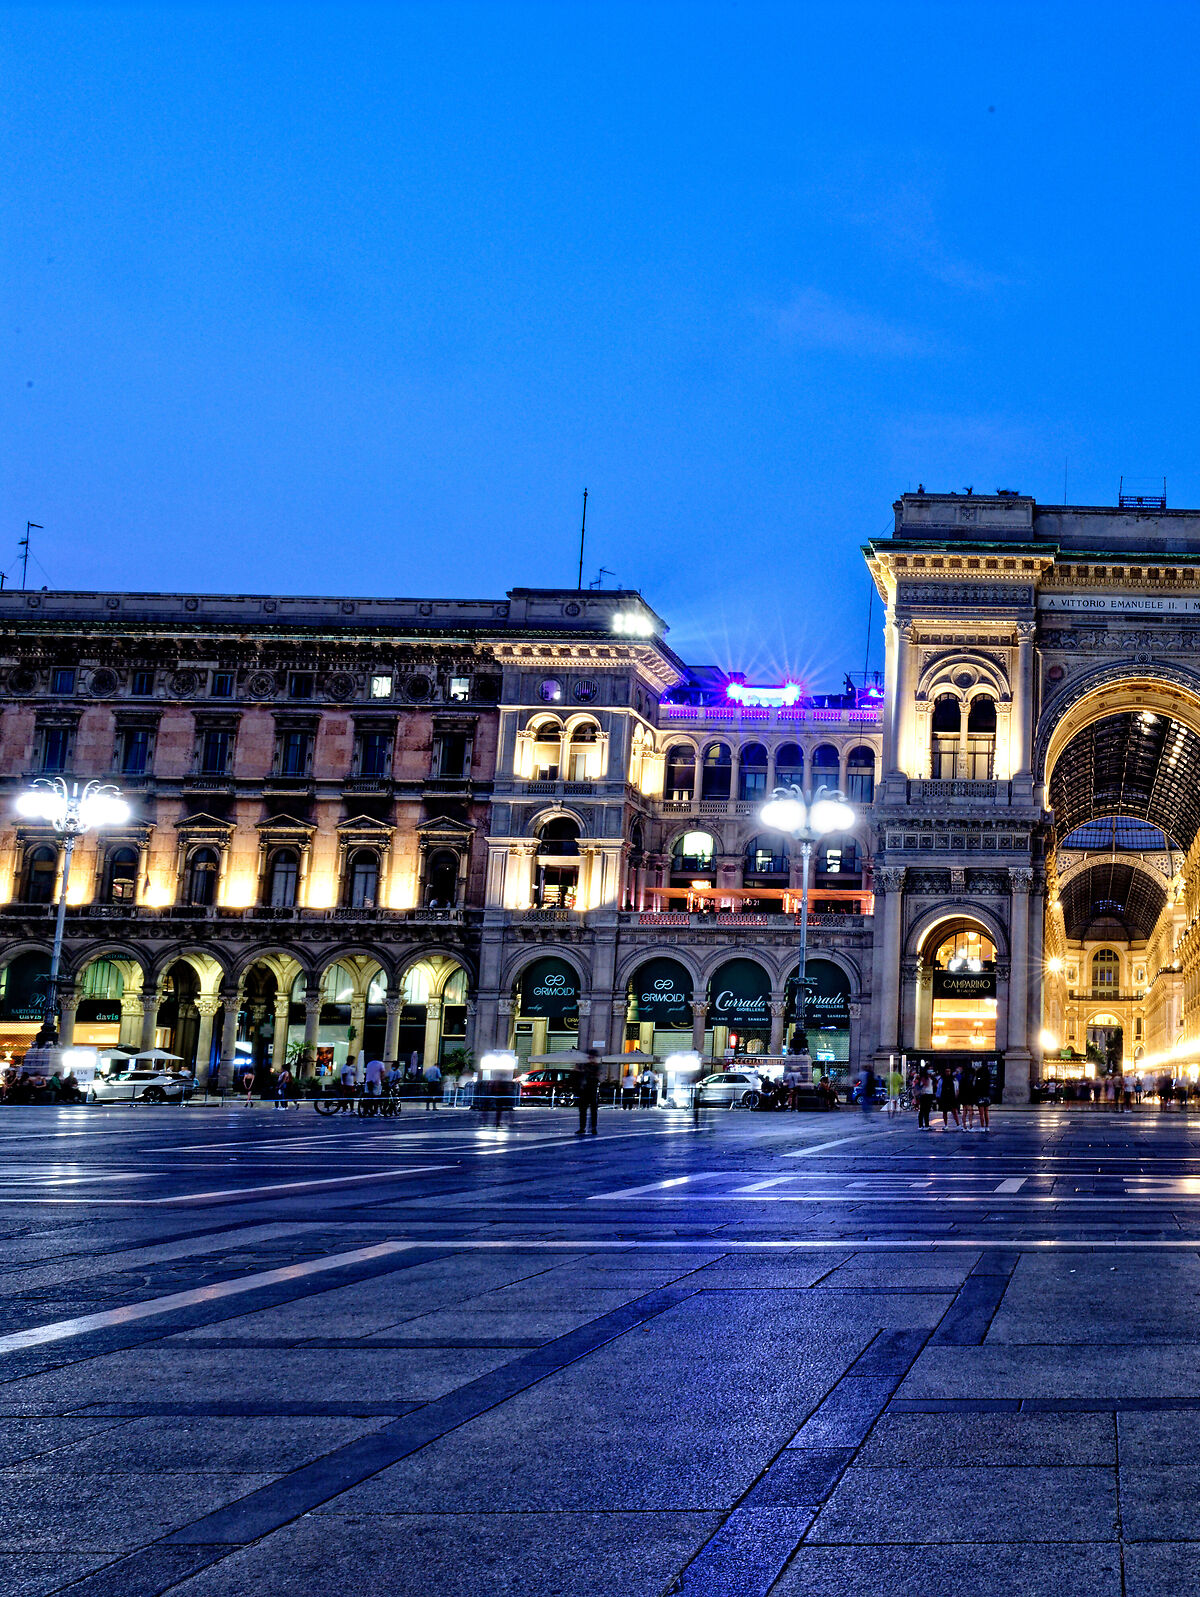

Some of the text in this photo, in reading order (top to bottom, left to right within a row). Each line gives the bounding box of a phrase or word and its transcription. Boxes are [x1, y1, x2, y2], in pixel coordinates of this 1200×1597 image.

[1048, 599, 1056, 607] A
[1061, 599, 1106, 608] VITTORIO
[1110, 600, 1163, 609] EMANUELE
[943, 979, 991, 989] CAMPARINO
[533, 986, 575, 996] GRIMOLDI
[641, 992, 685, 1002] GRIMOLDI
[715, 990, 766, 1011] Currado
[96, 1013, 119, 1021] davis
